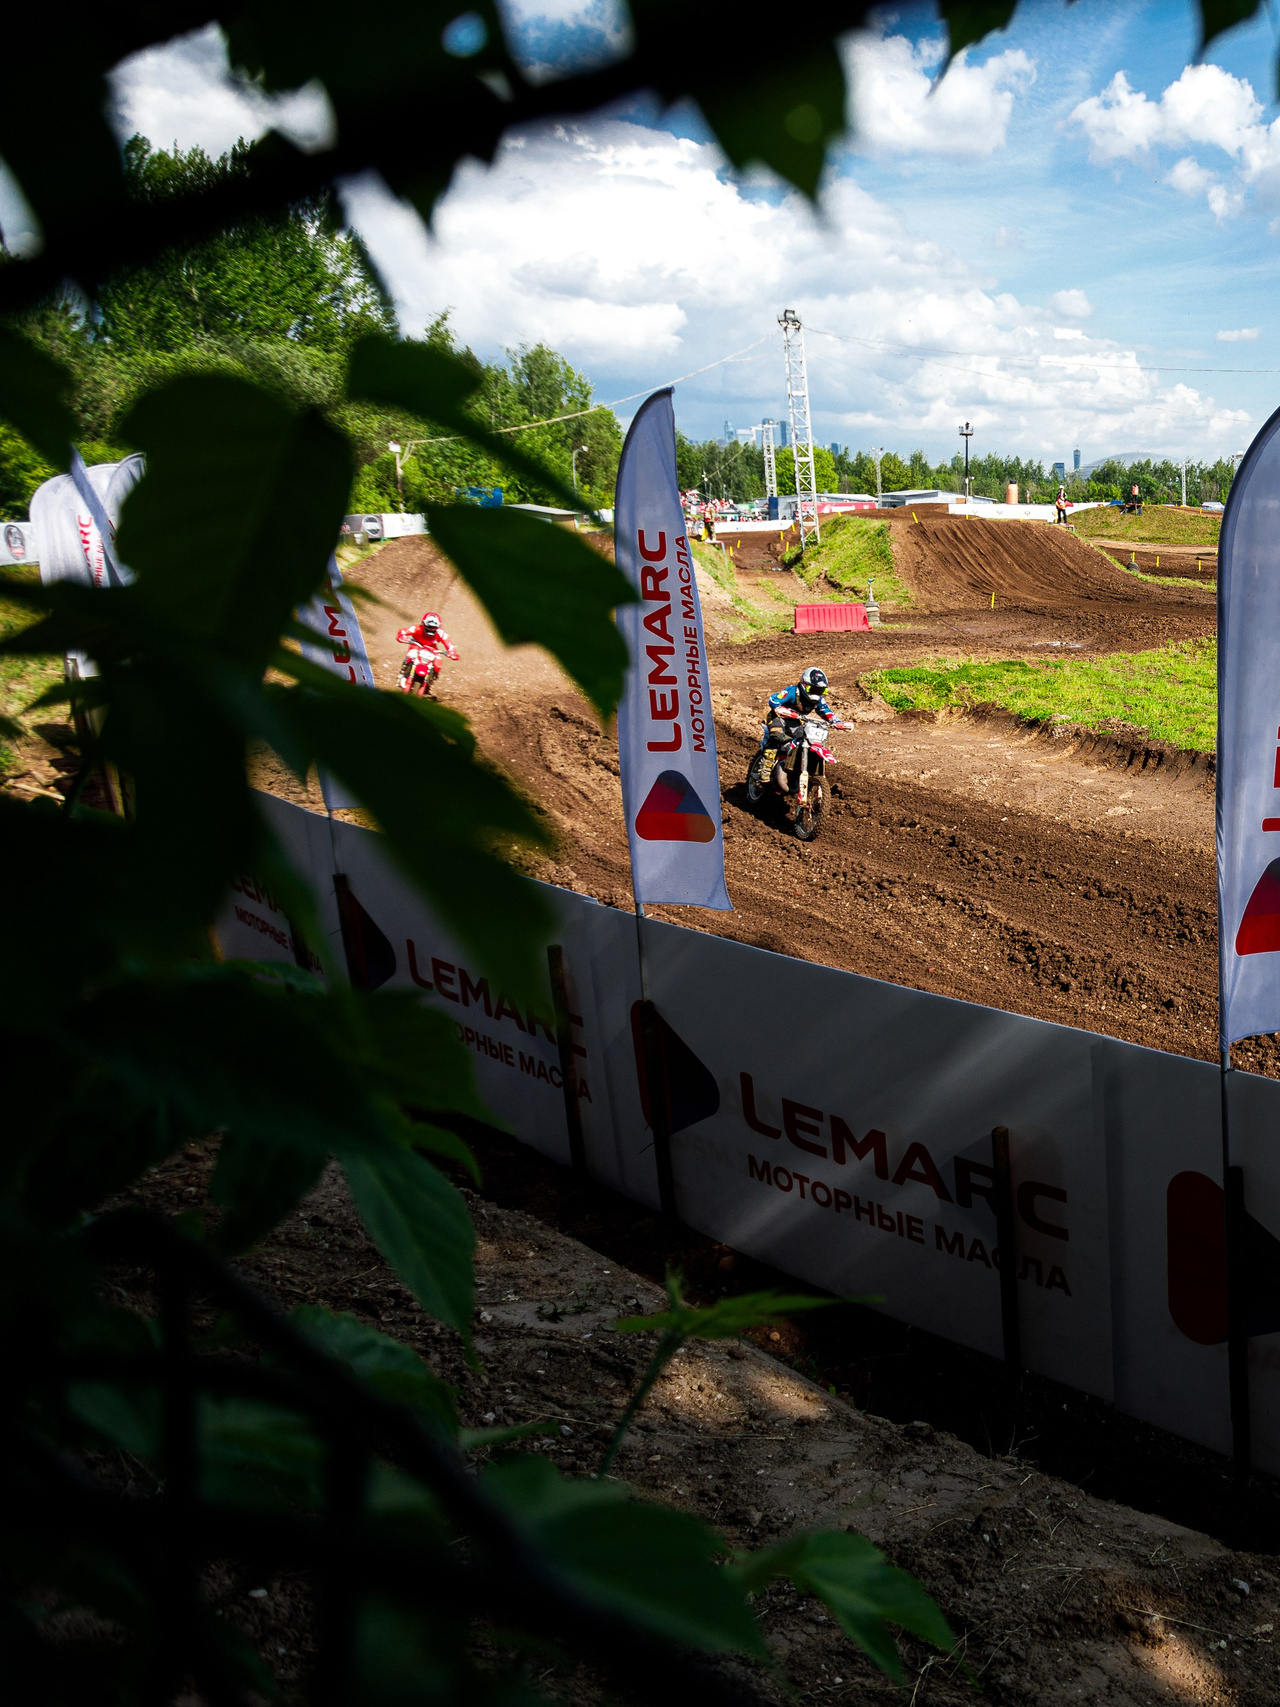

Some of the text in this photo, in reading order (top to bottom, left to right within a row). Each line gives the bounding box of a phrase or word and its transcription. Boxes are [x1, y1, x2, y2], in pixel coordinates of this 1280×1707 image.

[637, 529, 683, 752] LEMARC
[675, 535, 707, 753] МОТОРНЫЕ МАСЛА
[518, 1051, 592, 1103] МАСА
[740, 1072, 1069, 1241] LEMARC
[748, 1154, 925, 1245] МОТОРНЫЕ
